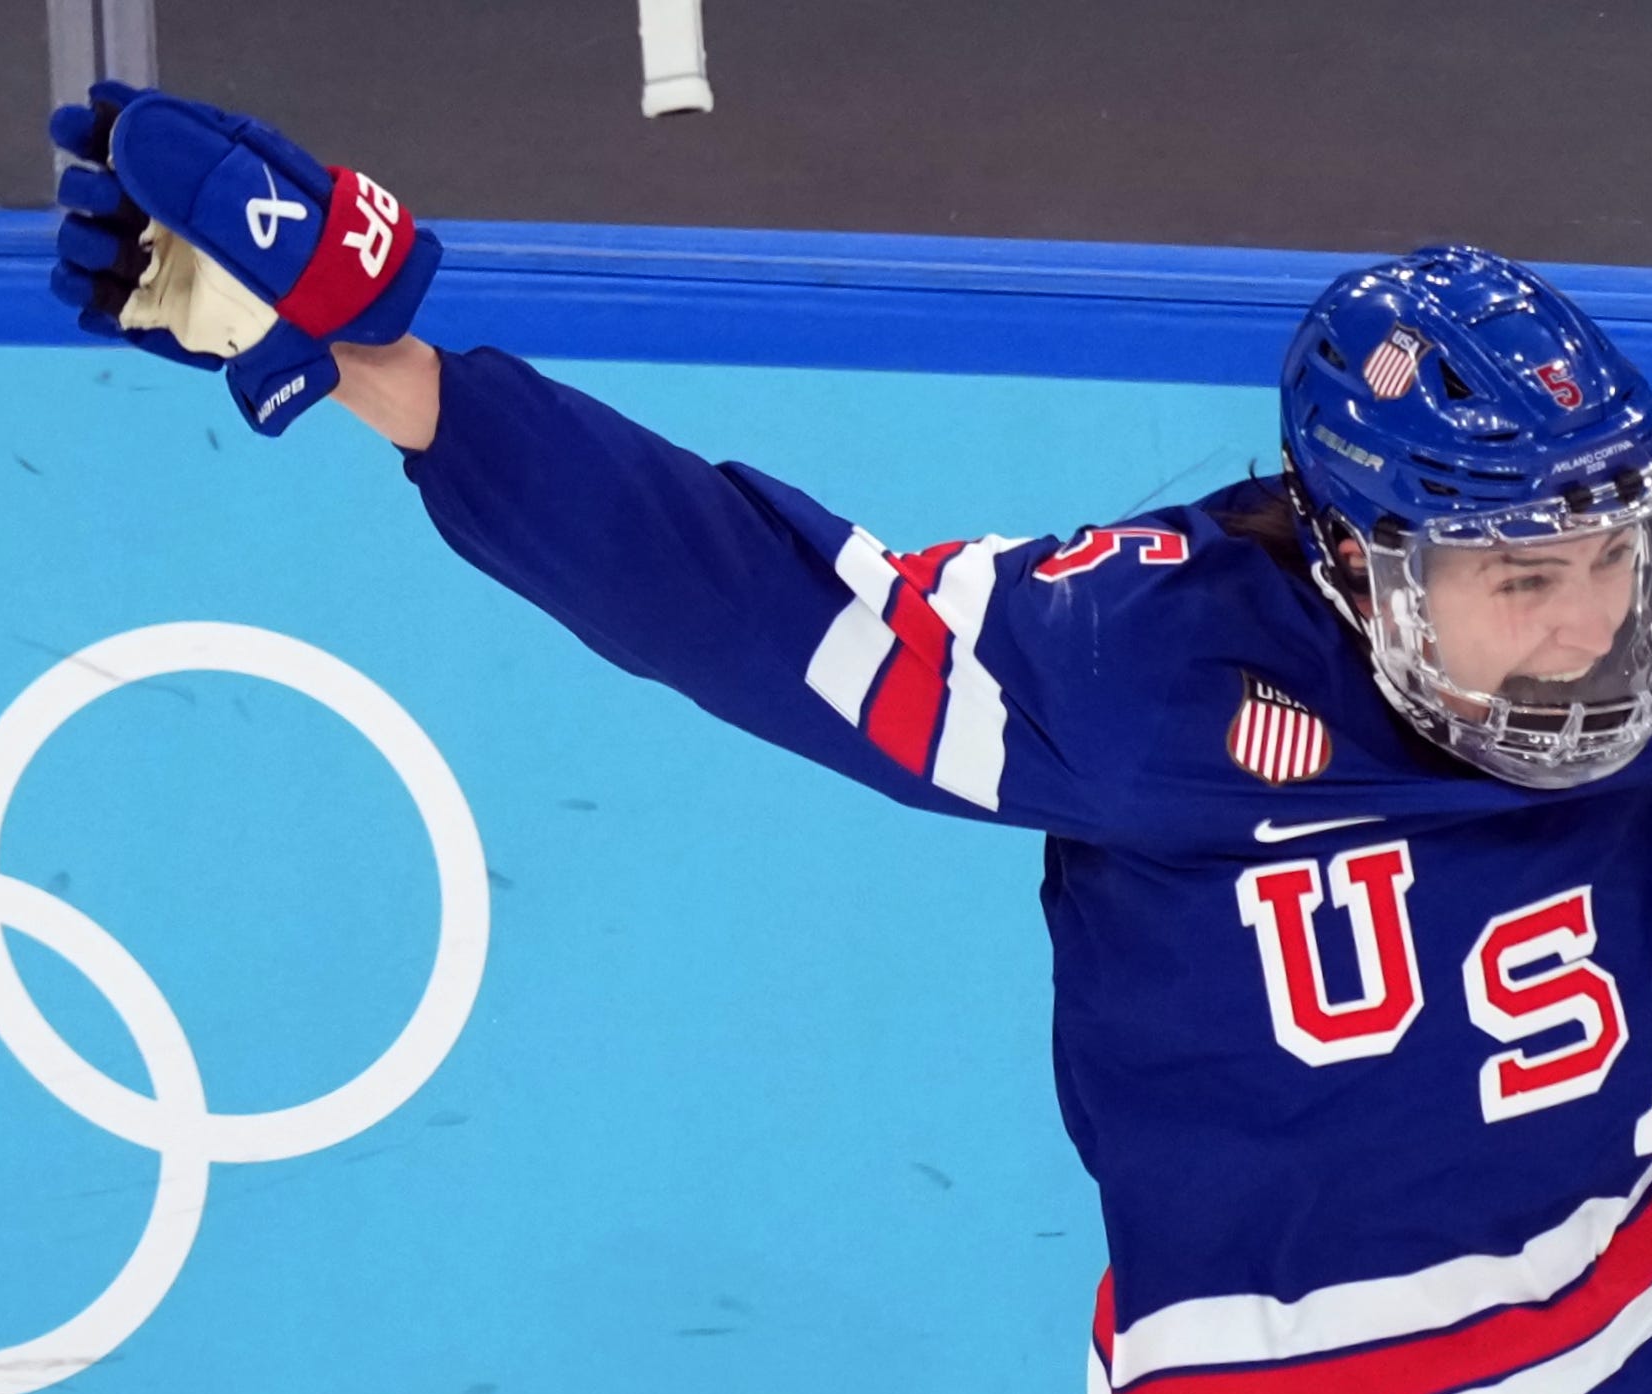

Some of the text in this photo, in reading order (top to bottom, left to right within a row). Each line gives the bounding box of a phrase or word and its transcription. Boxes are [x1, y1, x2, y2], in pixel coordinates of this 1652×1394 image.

[1391, 329, 1421, 361] USA
[1533, 359, 1583, 411] 5
[1551, 440, 1635, 475] MILANO CORTINA
